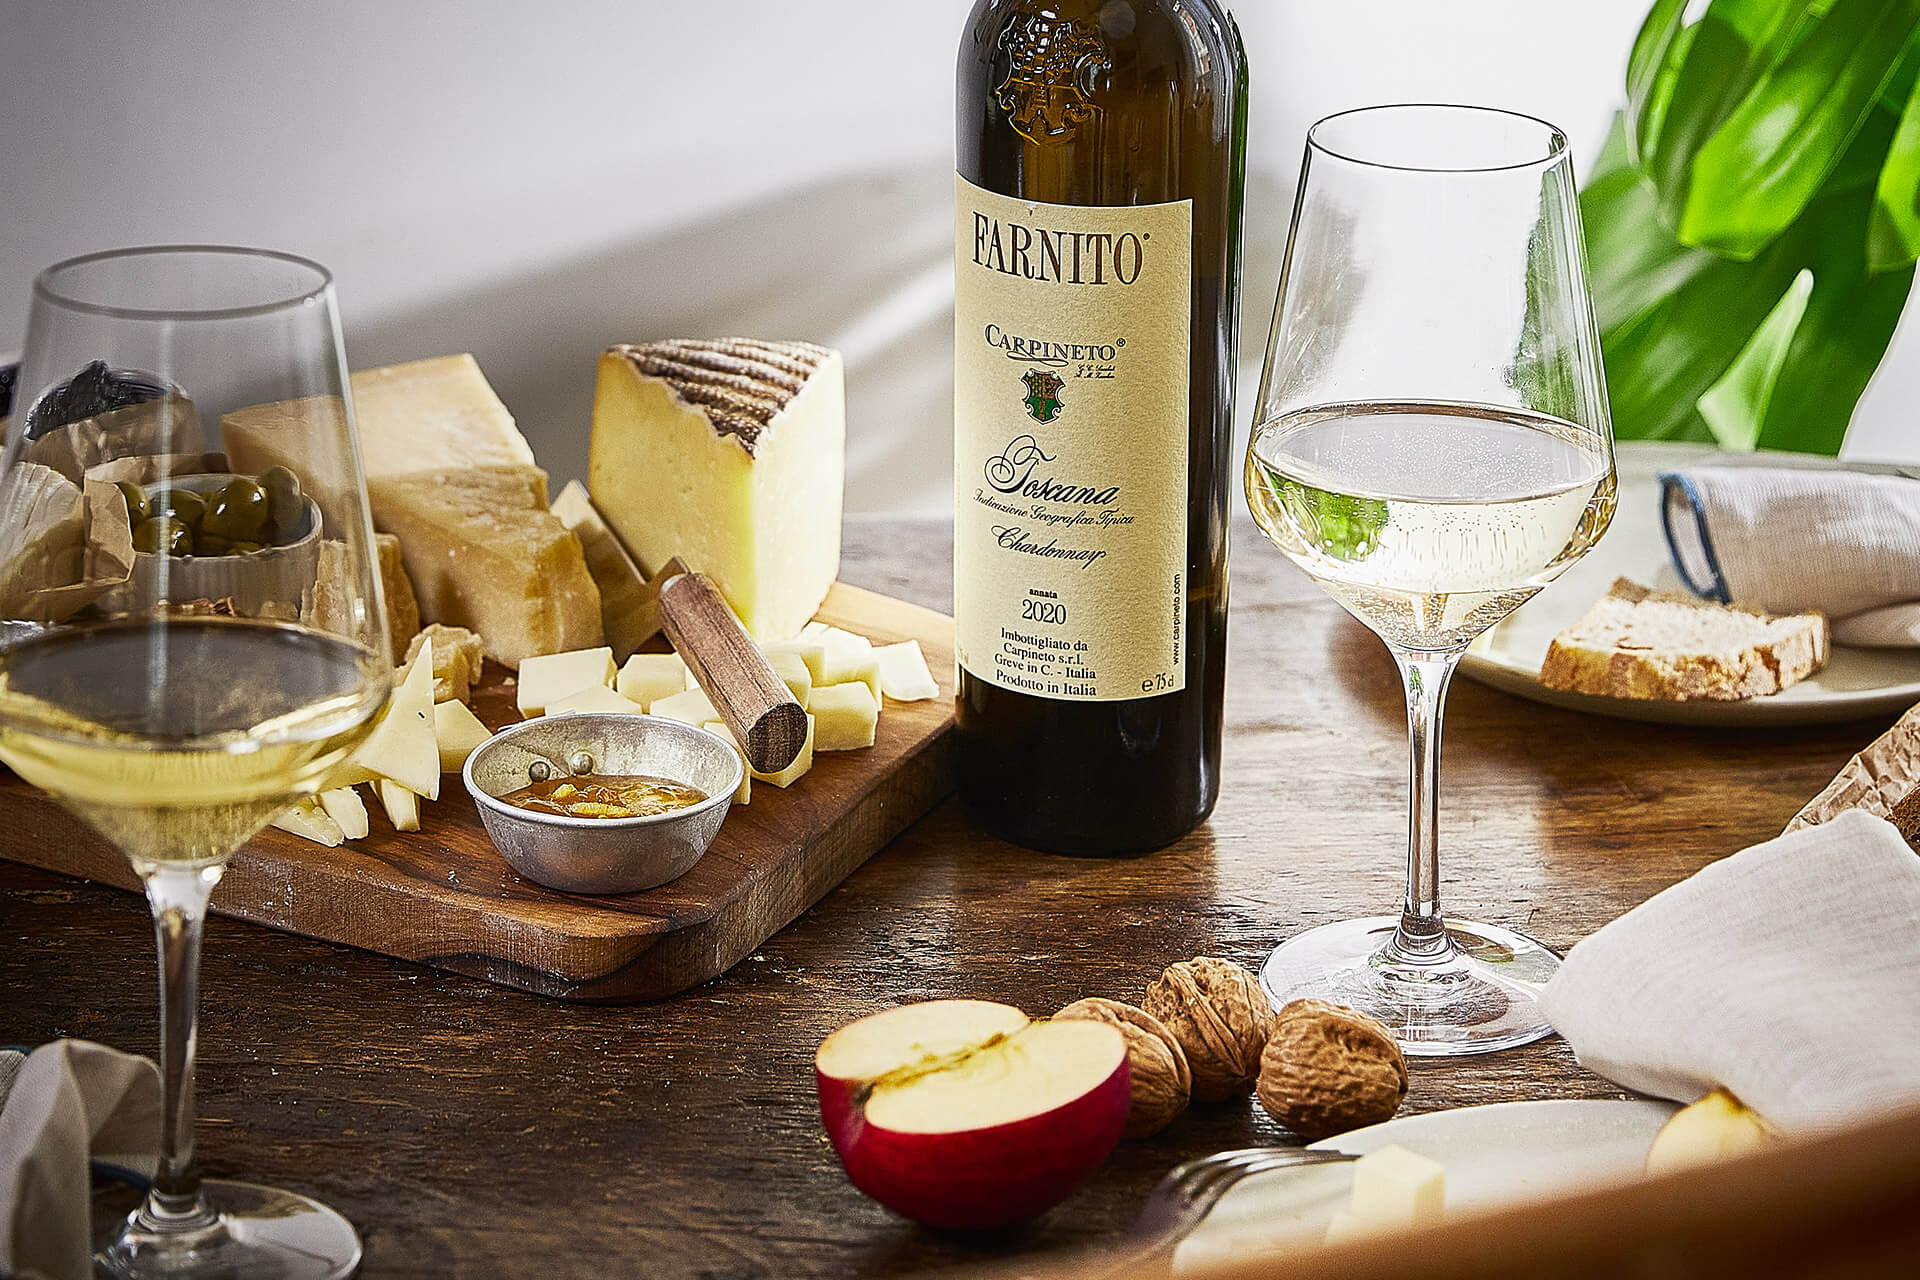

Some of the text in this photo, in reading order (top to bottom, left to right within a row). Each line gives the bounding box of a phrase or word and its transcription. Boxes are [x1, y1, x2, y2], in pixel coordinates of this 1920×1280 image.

[985, 435, 1120, 505] Toscana
[973, 488, 1135, 529] Indicazione Geografica Tipica
[991, 525, 1107, 569] Chardonnay
[1029, 588, 1058, 599] annata
[1022, 599, 1067, 625] 2020
[1173, 574, 1181, 665] www.carpineto.com
[1001, 627, 1088, 651] Imbottigliato da
[994, 653, 1024, 671] Greve
[1027, 661, 1038, 674] in
[1041, 665, 1054, 676] C.
[1065, 667, 1096, 679] Italia
[1003, 643, 1084, 665] Carpineto s.r.l.
[996, 670, 1097, 696] Prodotto in Italia
